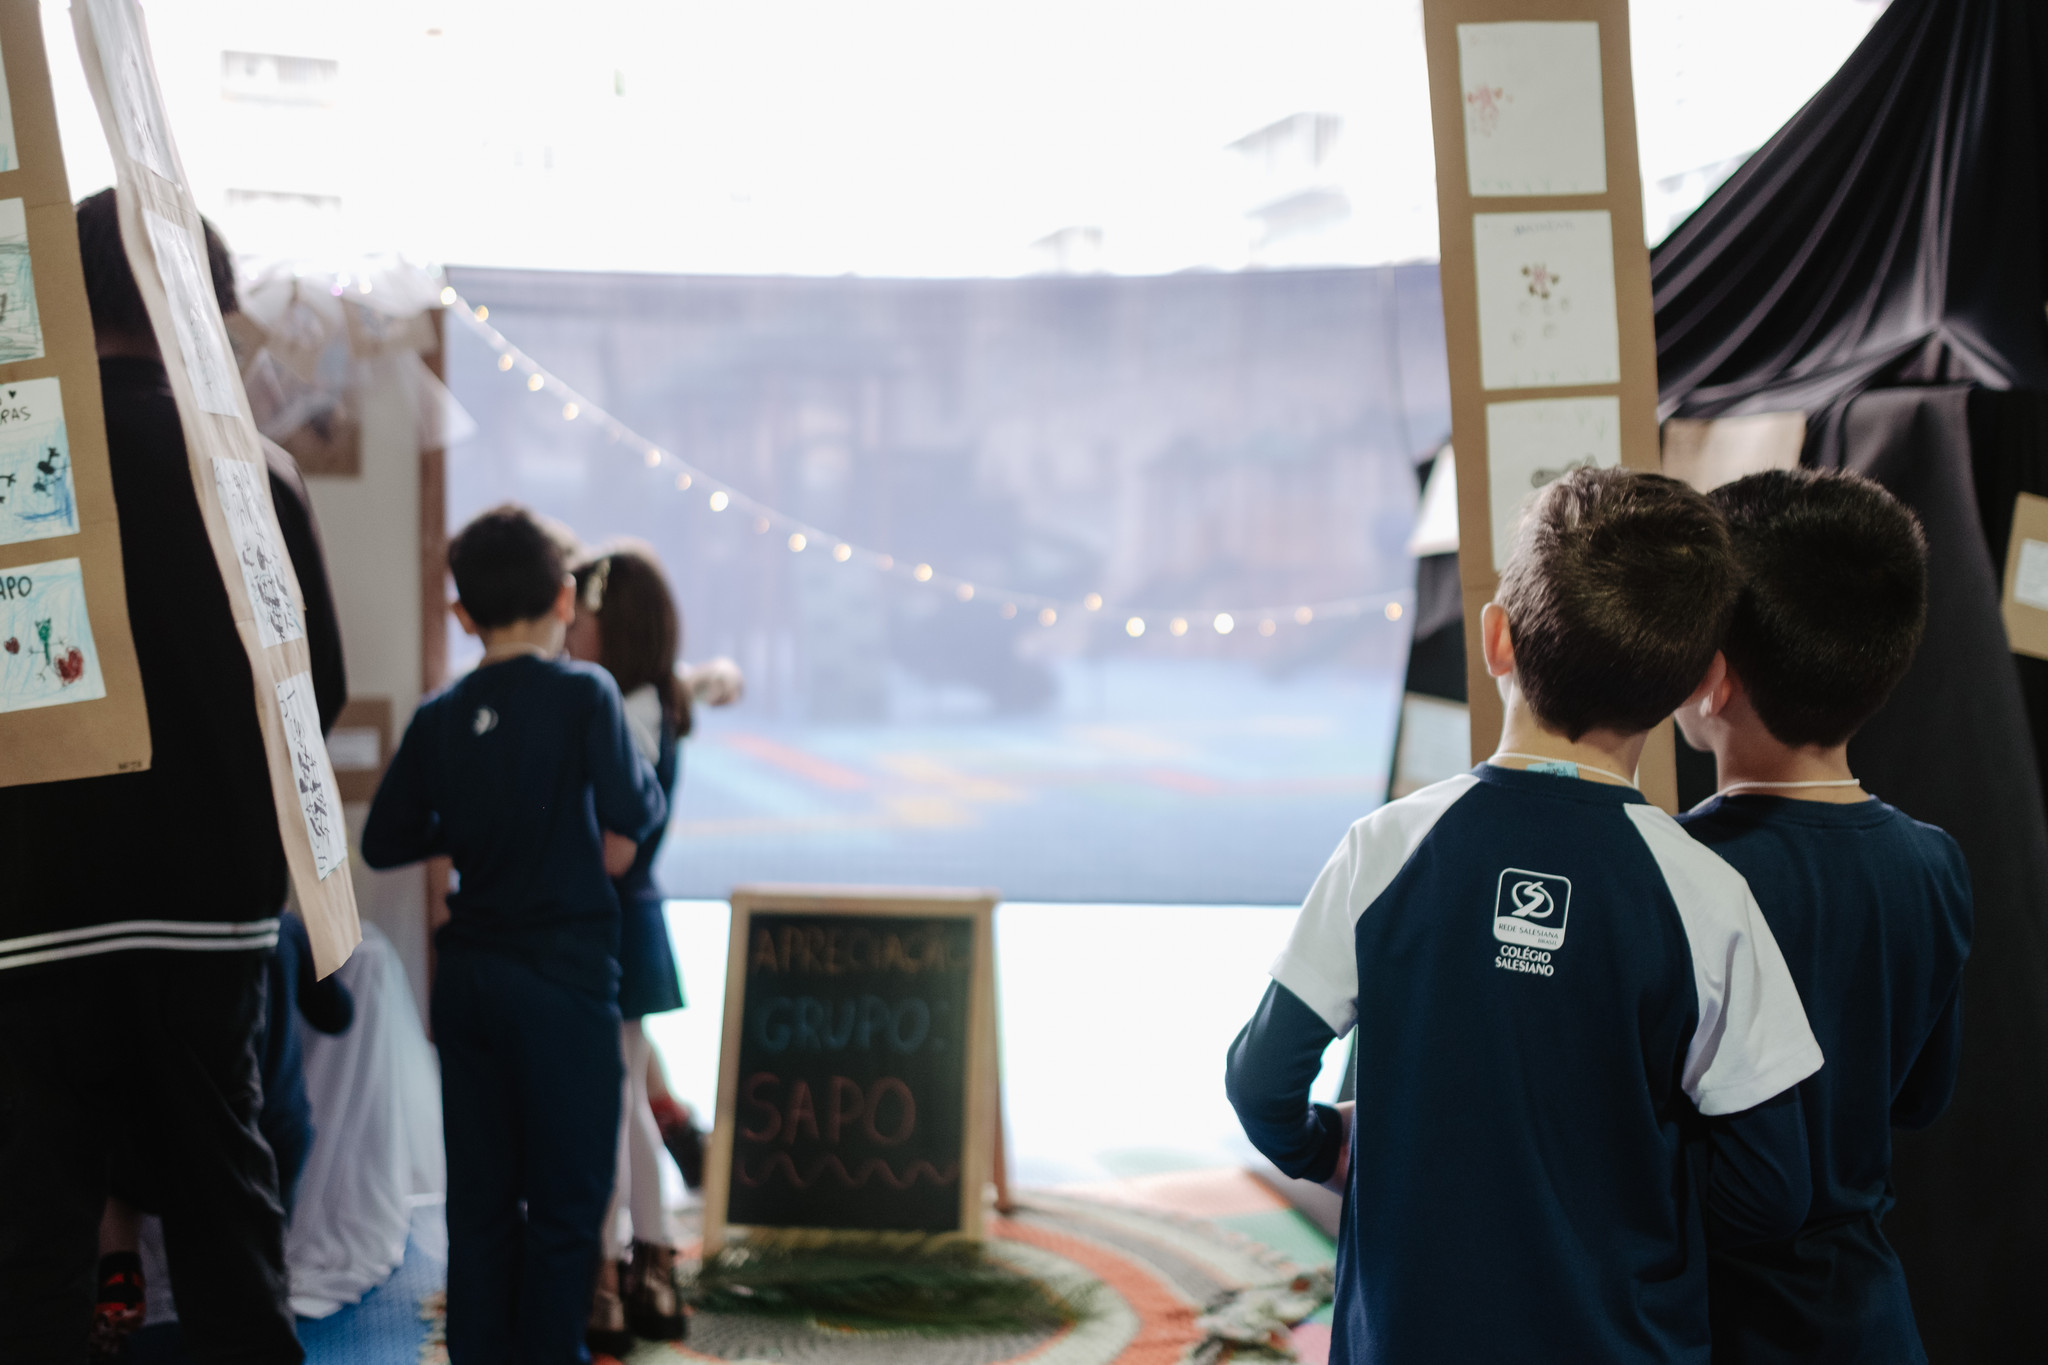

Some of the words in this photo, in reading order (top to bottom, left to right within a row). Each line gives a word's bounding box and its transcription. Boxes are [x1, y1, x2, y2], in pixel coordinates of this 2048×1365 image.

[1498, 923, 1517, 934] REDE
[1519, 927, 1559, 939] SALESIANA
[1500, 944, 1551, 964] COLÉGIO
[1495, 956, 1555, 977] SALESIANO
[741, 1071, 916, 1146] SAPO
